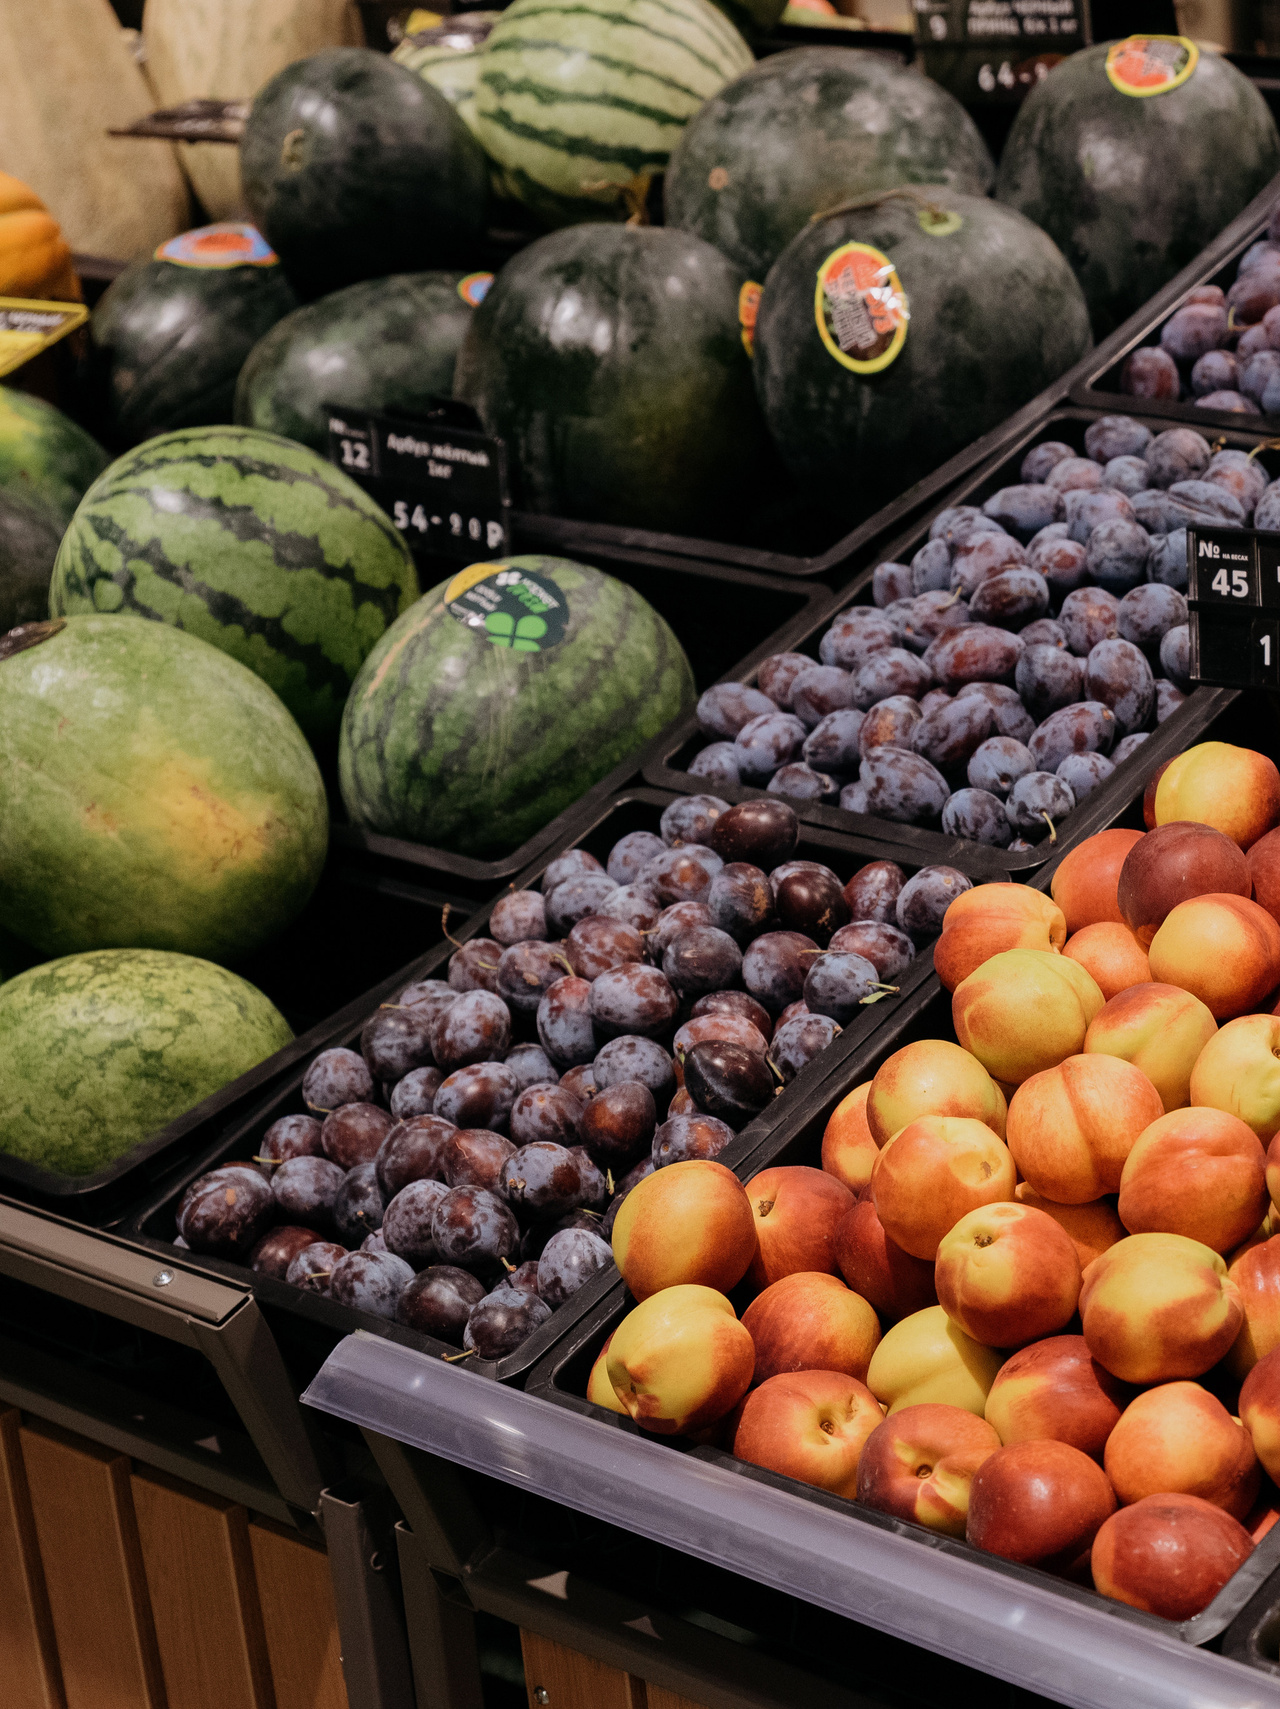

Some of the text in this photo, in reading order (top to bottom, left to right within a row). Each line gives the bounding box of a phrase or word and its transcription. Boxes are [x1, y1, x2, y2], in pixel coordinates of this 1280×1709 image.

[340, 439, 370, 470] 12
[1199, 540, 1220, 558] №
[1231, 553, 1248, 561] ВЕСАХ
[1211, 569, 1249, 598] 45
